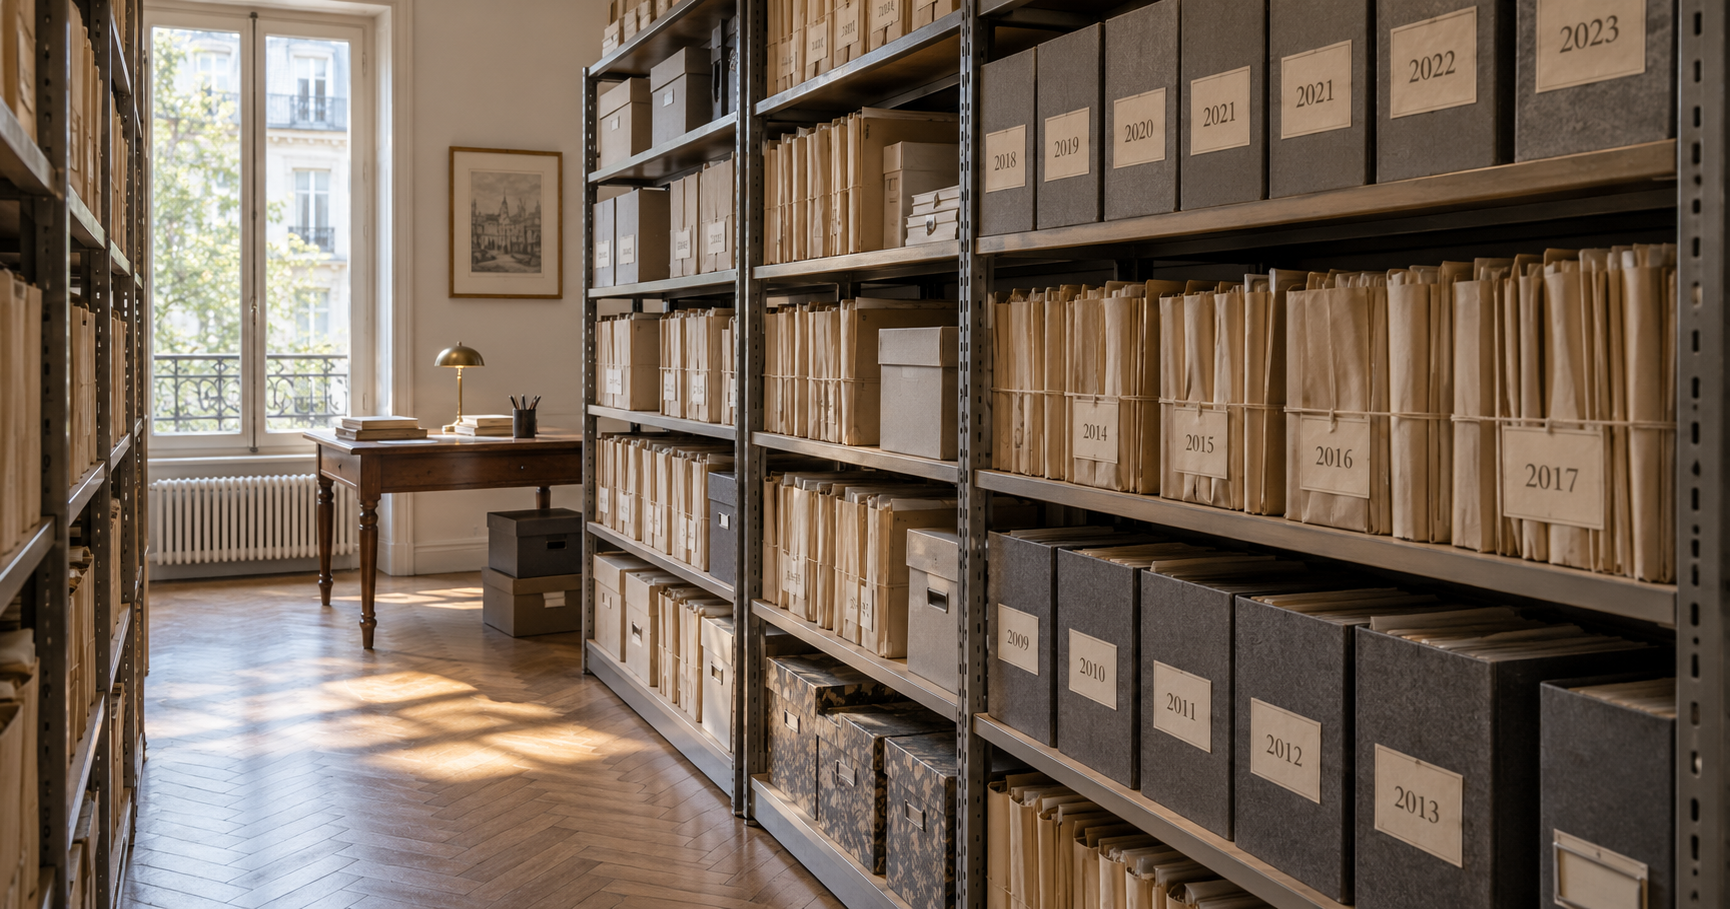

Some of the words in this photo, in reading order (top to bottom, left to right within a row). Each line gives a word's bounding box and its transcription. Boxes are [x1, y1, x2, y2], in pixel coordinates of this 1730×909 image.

[1559, 14, 1620, 54] 2023
[1409, 50, 1456, 84] 2022
[1296, 79, 1334, 109] 2021
[1203, 101, 1236, 128] 2021
[1124, 119, 1154, 143] 2020
[1054, 136, 1079, 158] 2019
[994, 151, 1017, 171] 2018
[1083, 423, 1108, 442] 2014
[1185, 433, 1214, 454] 2015
[1315, 445, 1353, 469] 2016
[1525, 463, 1579, 493] 2017
[1007, 629, 1030, 651] 2009
[1079, 657, 1106, 683] 2010
[1166, 692, 1196, 721] 2011
[1266, 733, 1303, 768] 2012
[1394, 785, 1440, 824] 2013
